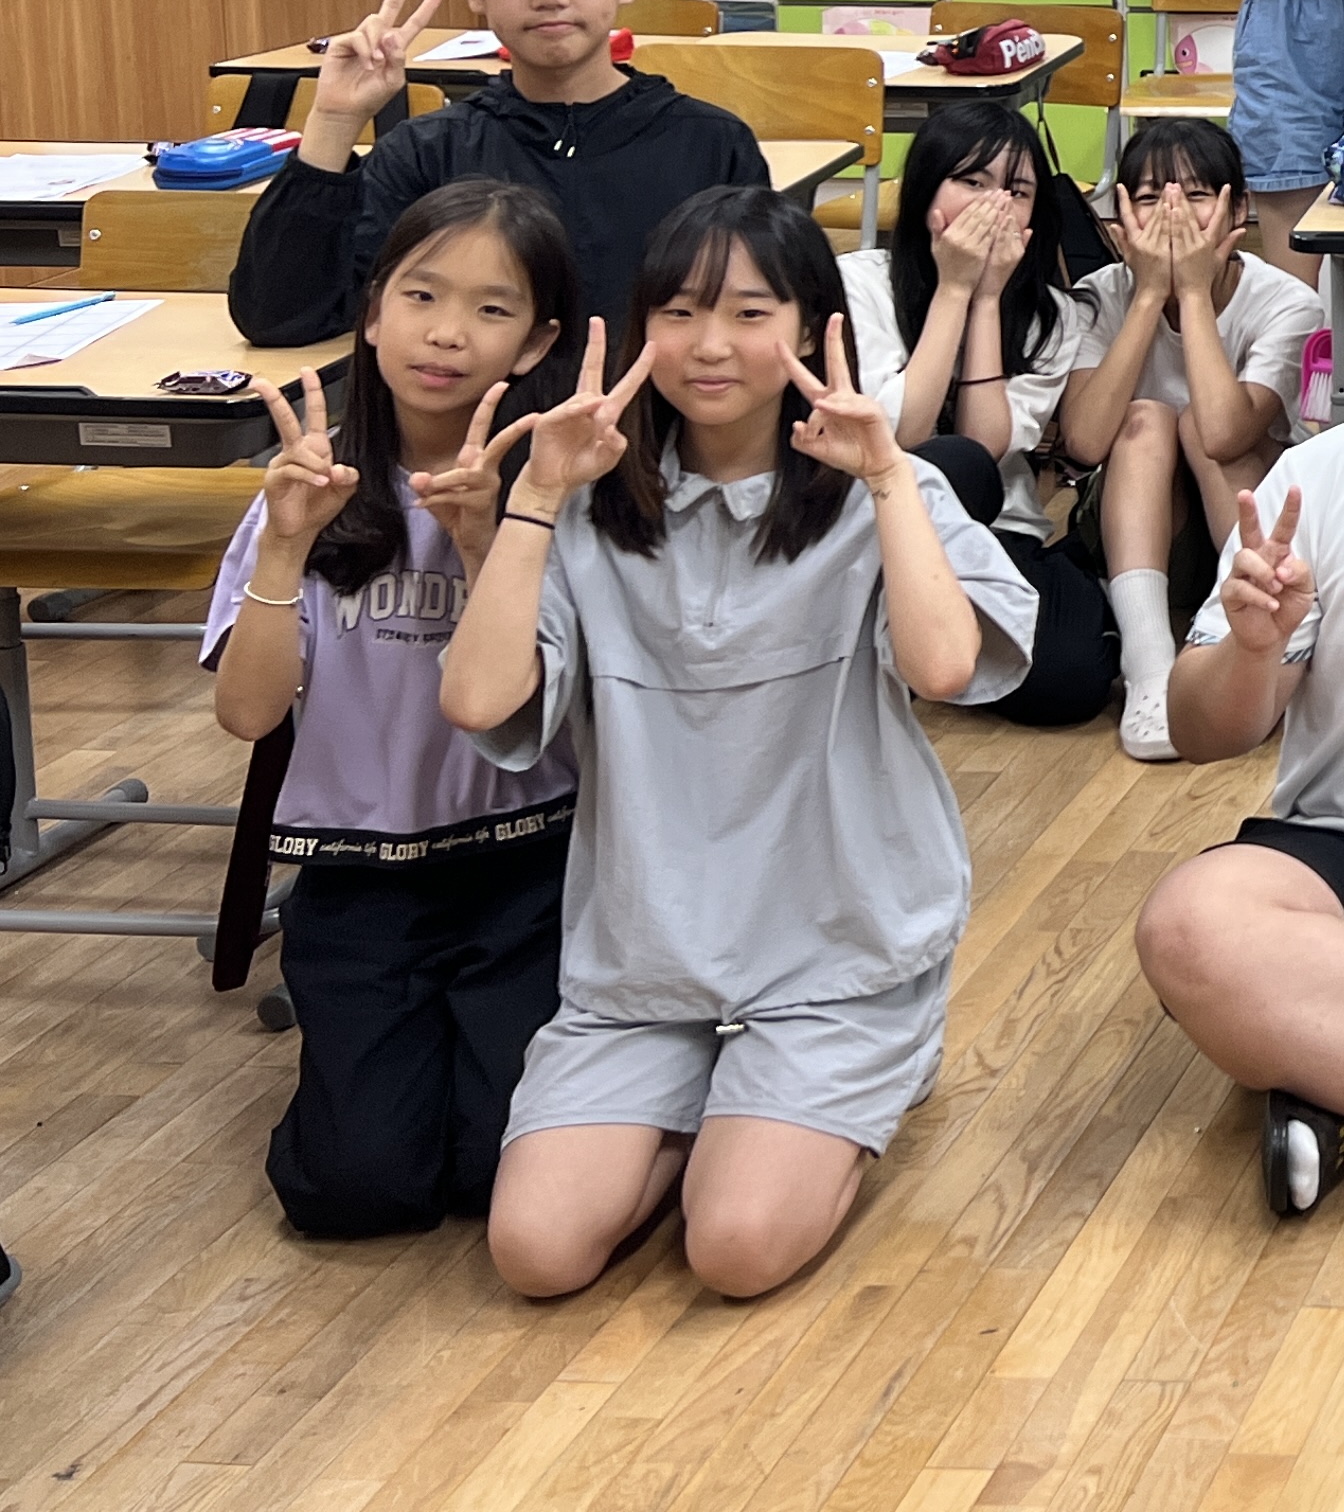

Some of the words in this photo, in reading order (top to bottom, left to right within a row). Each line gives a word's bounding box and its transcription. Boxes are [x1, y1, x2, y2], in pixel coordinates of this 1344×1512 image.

[269, 834, 319, 857] GLORY
[379, 840, 429, 861] GLORY
[494, 812, 546, 842] GLORY
